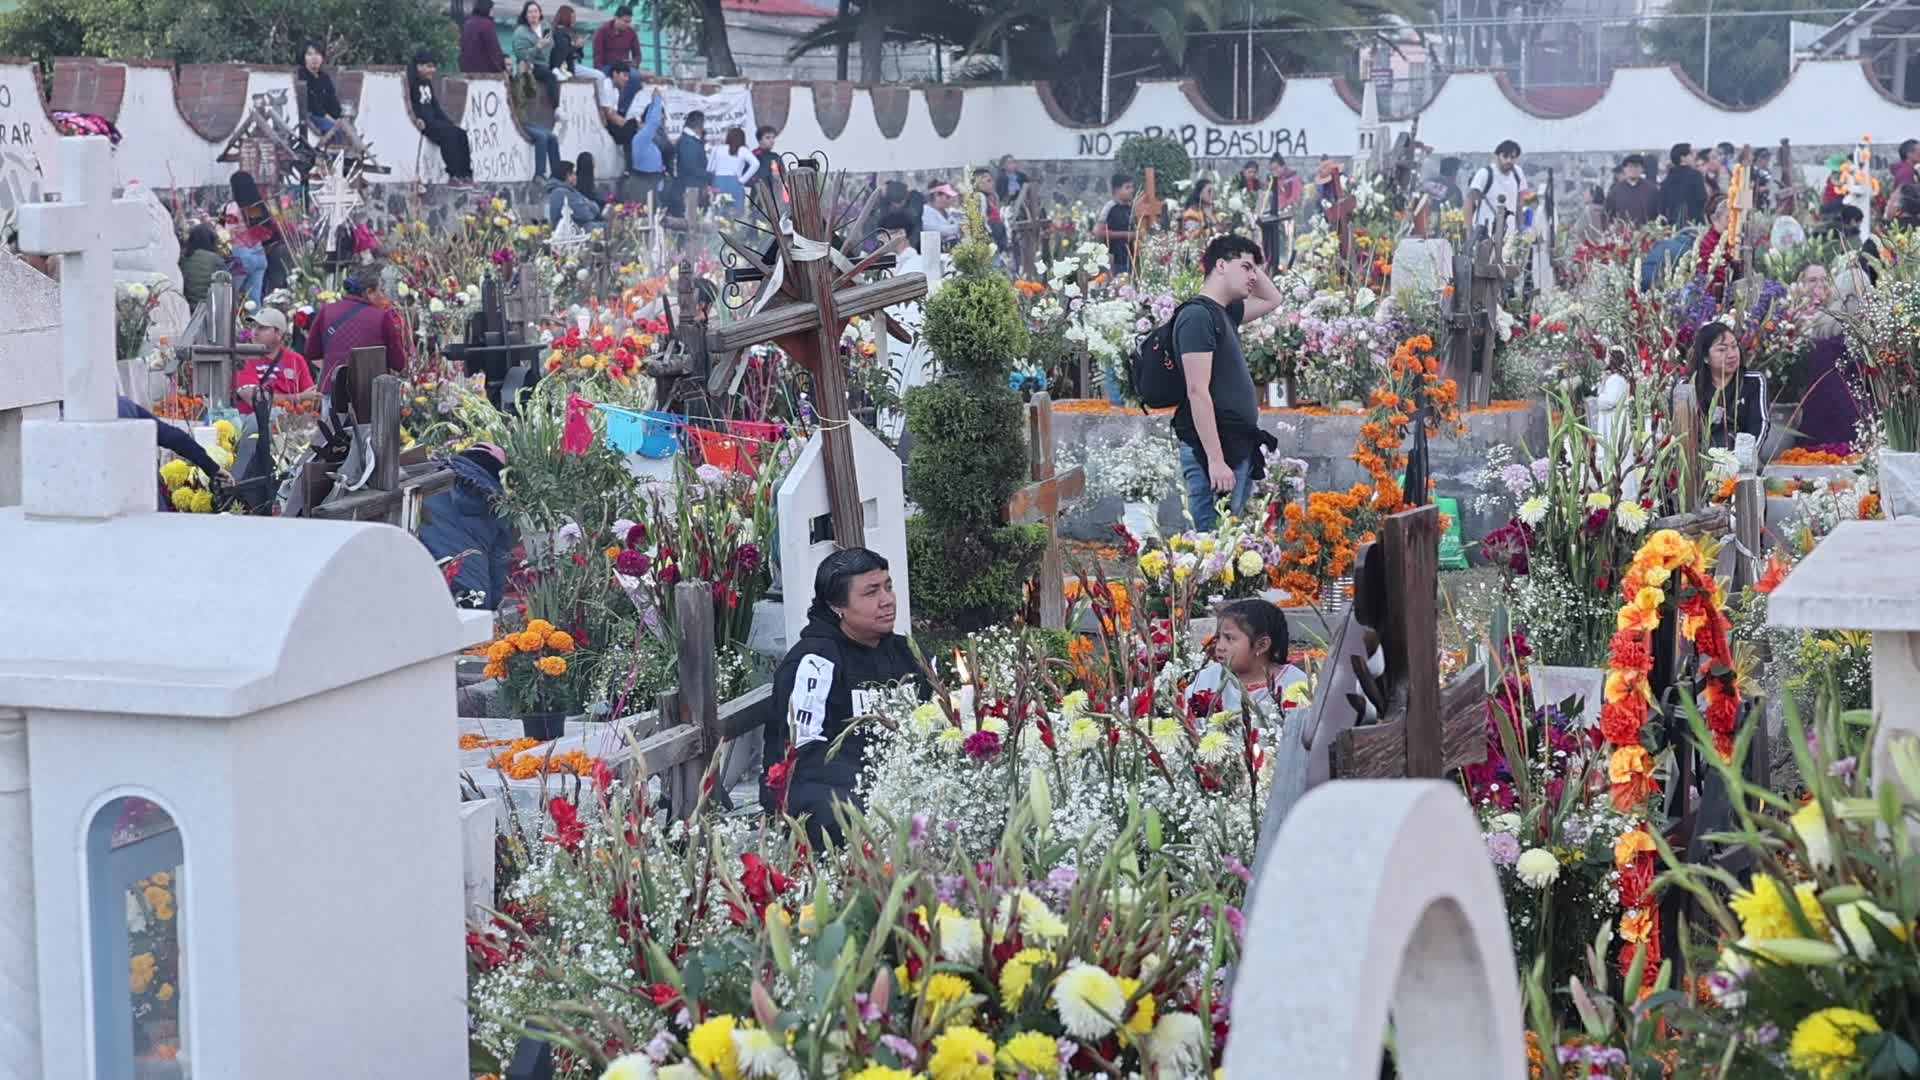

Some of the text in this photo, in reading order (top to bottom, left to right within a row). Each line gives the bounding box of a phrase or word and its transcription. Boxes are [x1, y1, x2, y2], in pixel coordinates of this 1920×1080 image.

[471, 91, 498, 118] NO
[1079, 133, 1112, 156] NO
[1205, 127, 1309, 157] BASURA
[471, 151, 517, 181] ASURA
